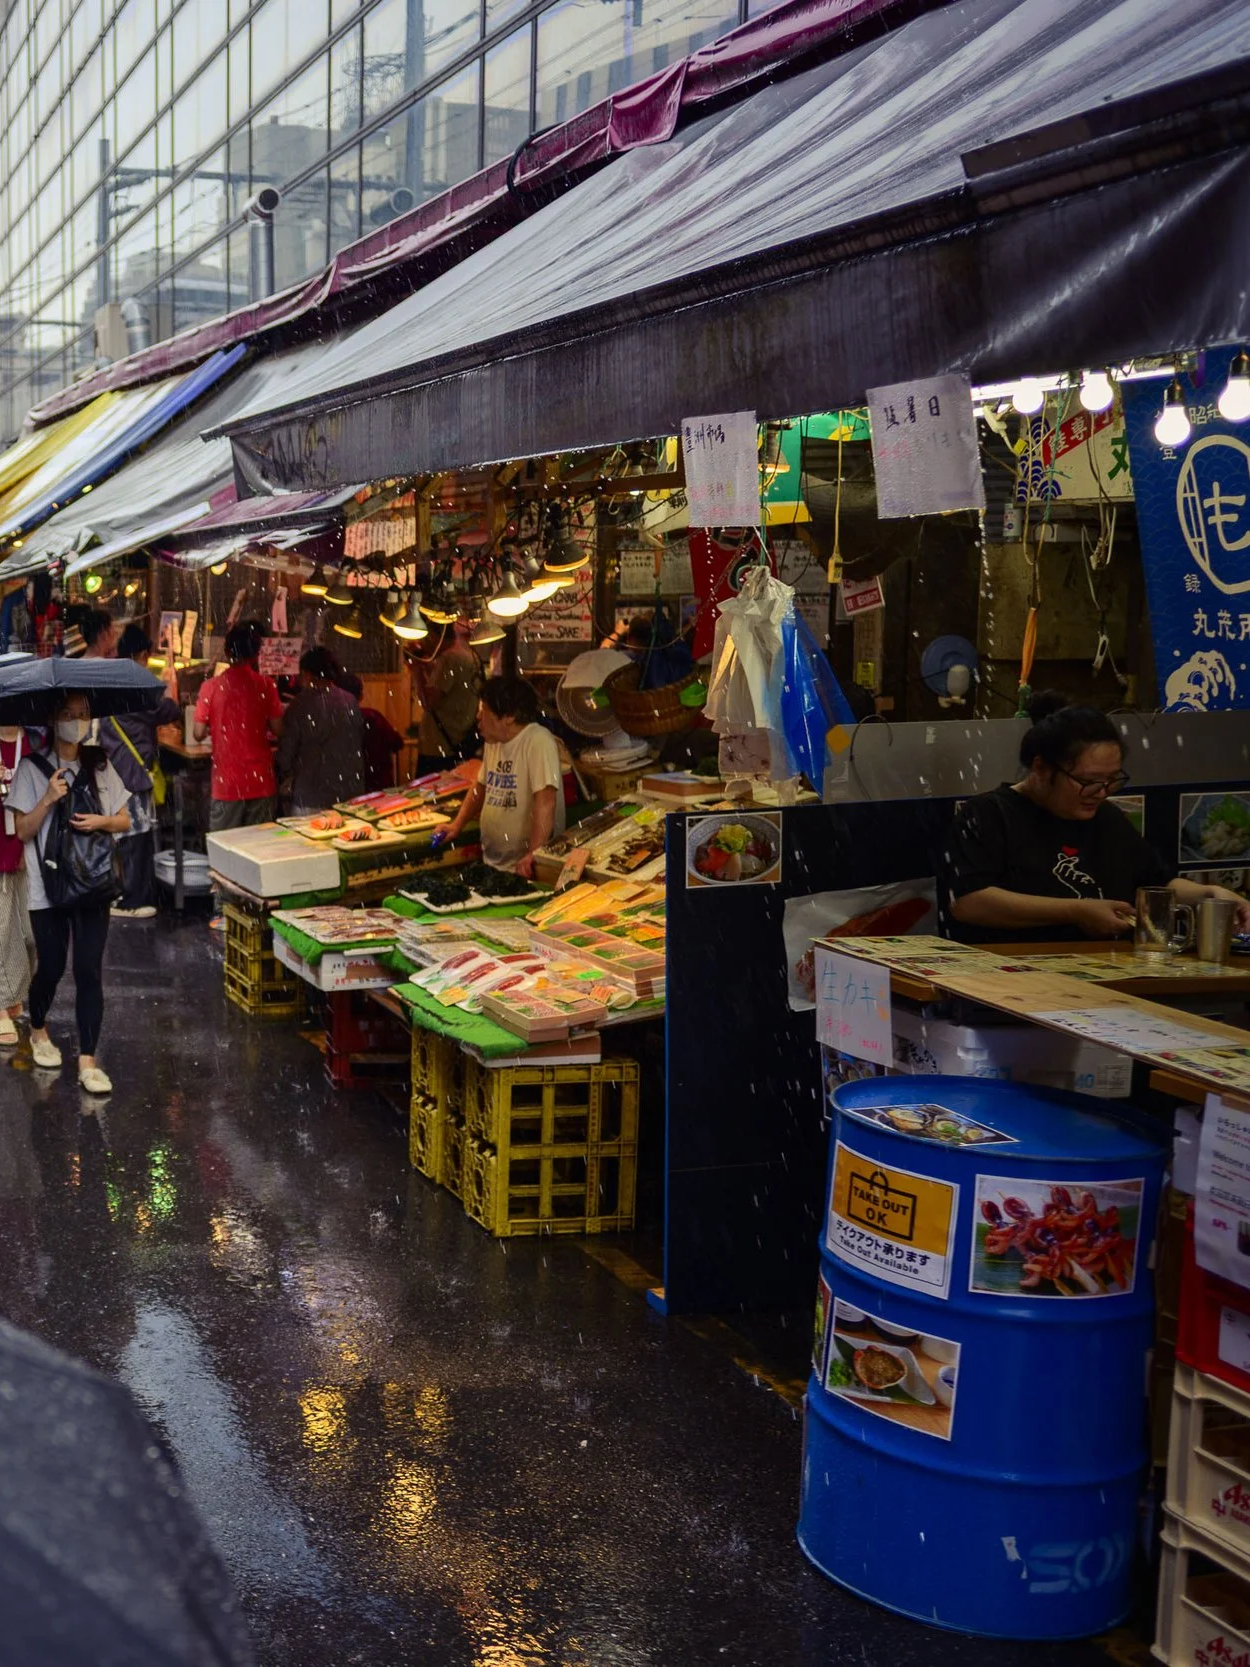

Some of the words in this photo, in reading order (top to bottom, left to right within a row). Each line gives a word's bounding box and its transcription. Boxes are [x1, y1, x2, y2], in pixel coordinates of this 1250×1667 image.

[852, 1186, 880, 1206] TAKE
[881, 1199, 910, 1216] OUT
[865, 1207, 889, 1227] OK
[836, 1219, 931, 1267] テイクアウト承ります
[839, 1235, 856, 1250] Take
[857, 1246, 872, 1258] Out
[873, 1253, 920, 1275] Available
